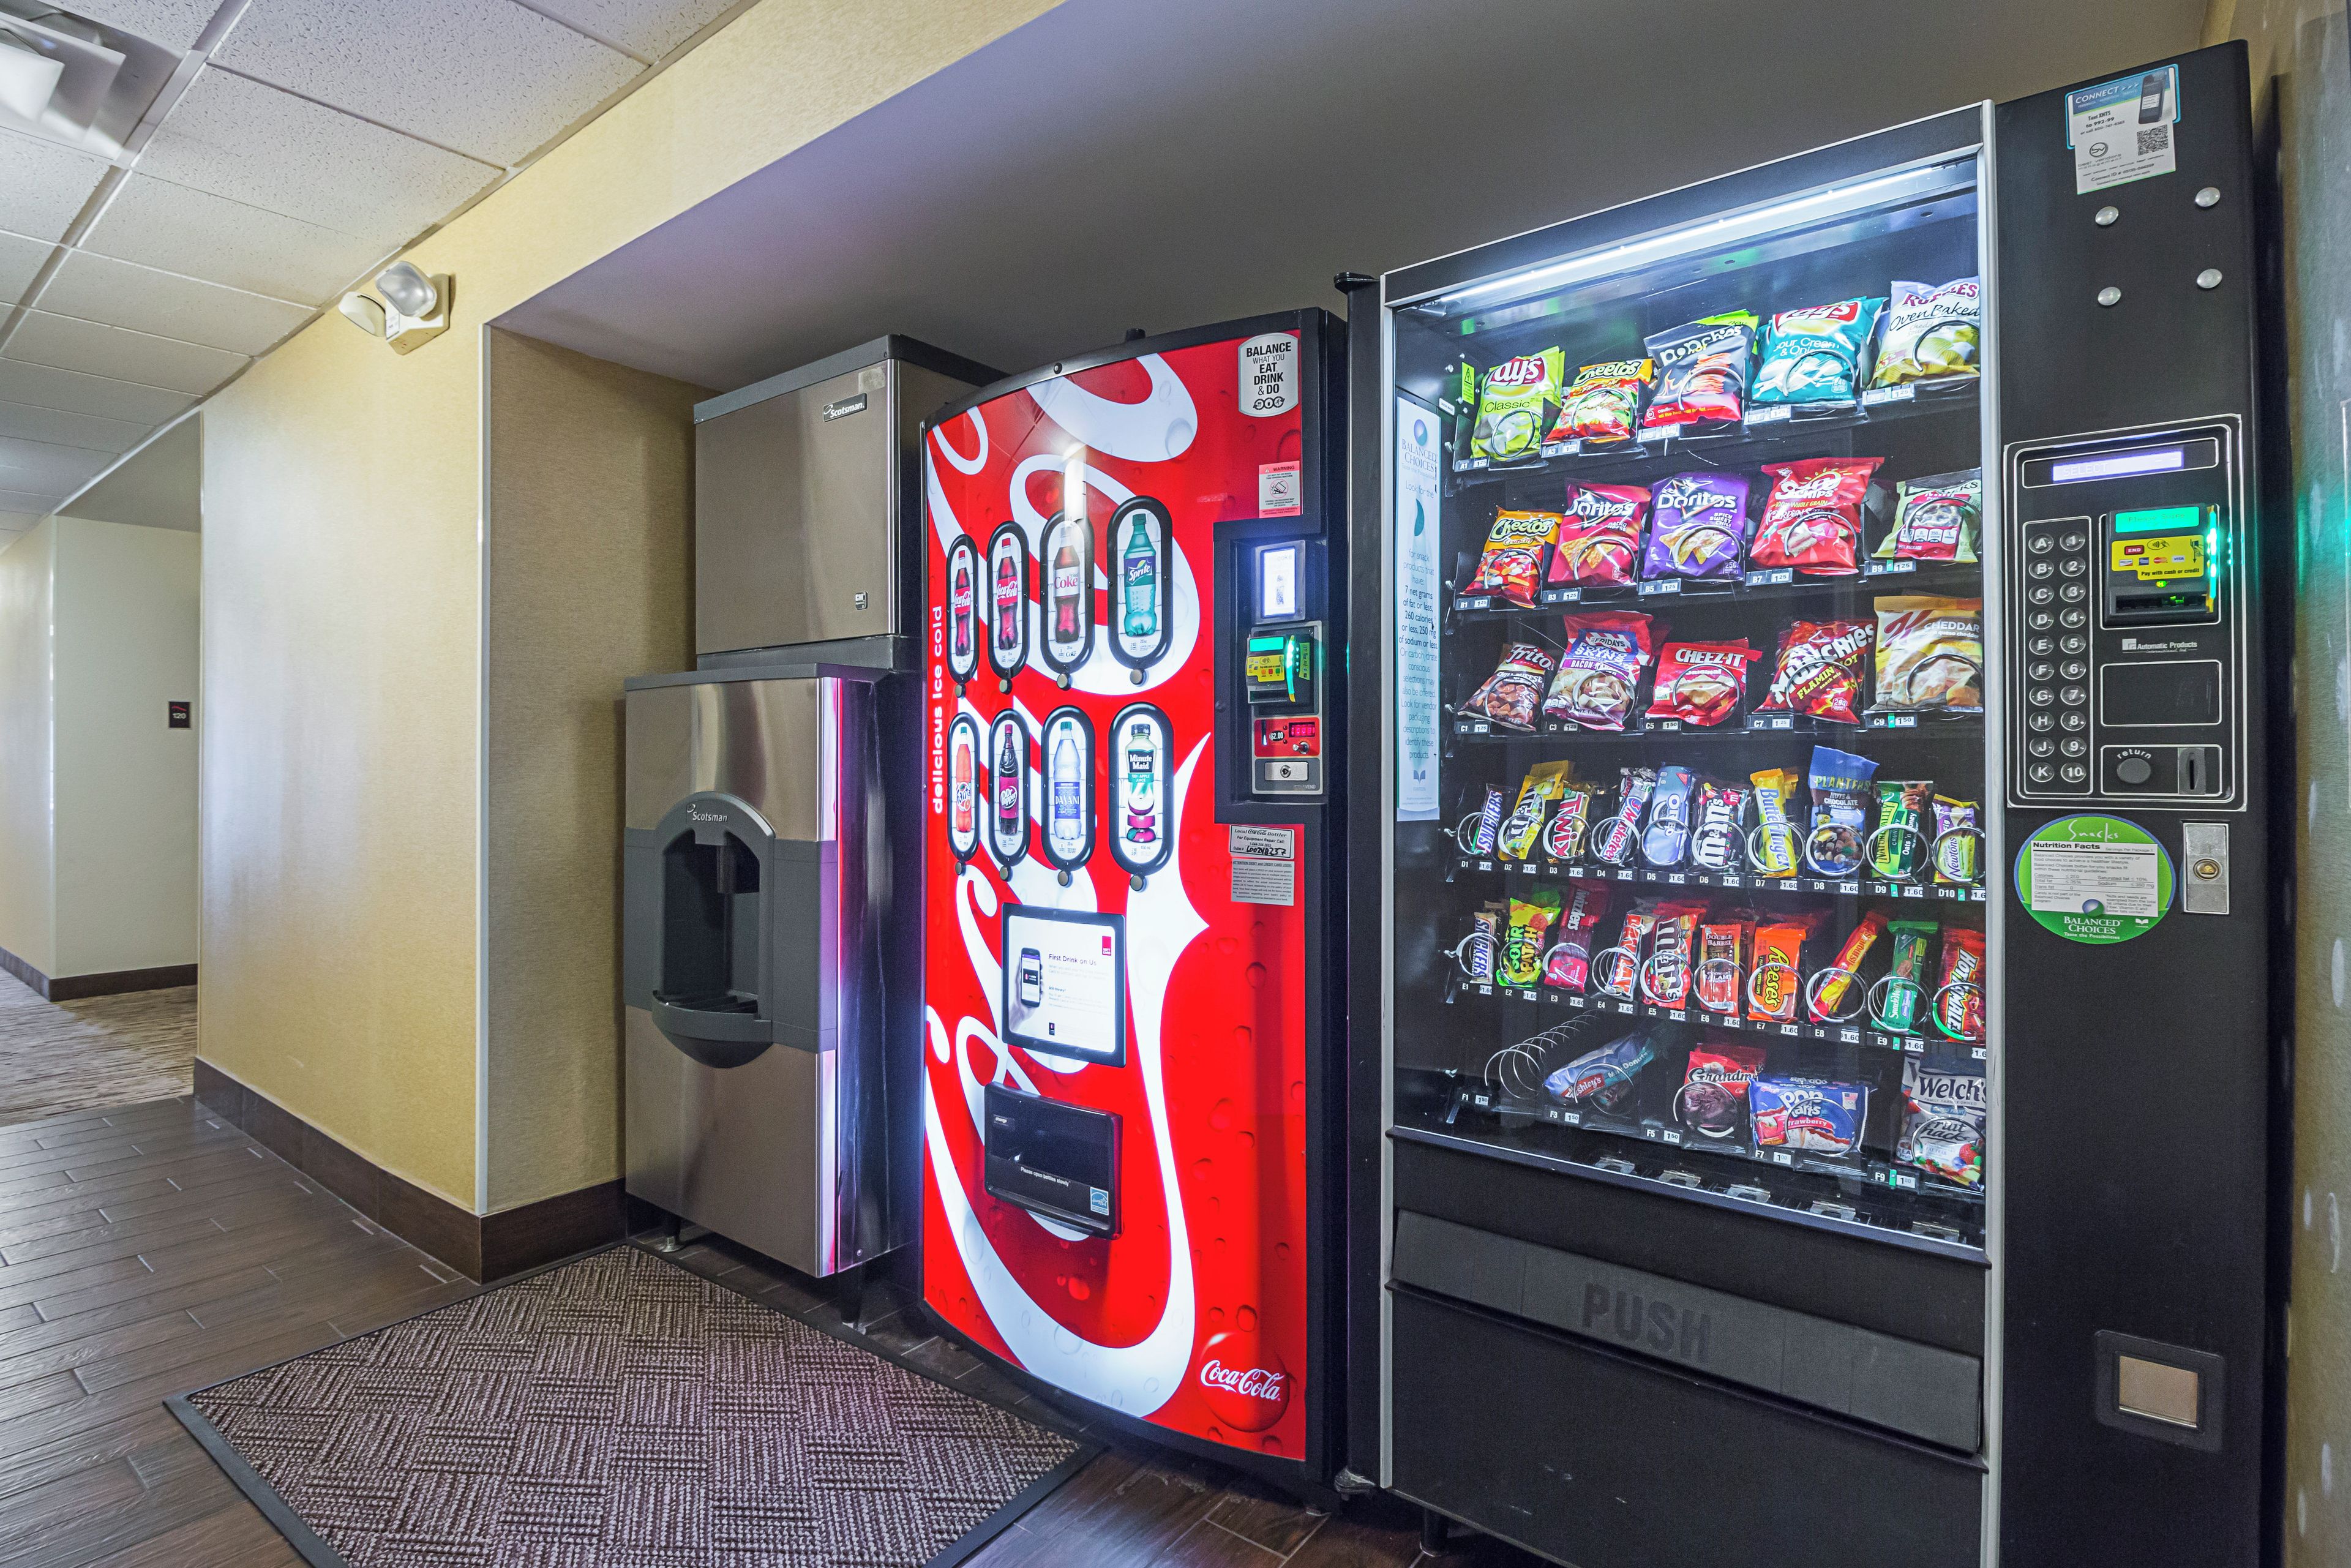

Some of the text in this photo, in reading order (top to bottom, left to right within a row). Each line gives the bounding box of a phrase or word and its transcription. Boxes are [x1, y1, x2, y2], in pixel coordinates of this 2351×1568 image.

[2075, 86, 2119, 103] CONNECT
[1889, 301, 1980, 330] Oven Baked
[1247, 342, 1291, 357] BALANCE
[1253, 353, 1284, 365] WHAT YOU
[1572, 360, 1643, 386] Cheetos
[1254, 372, 1284, 386] DRINK
[1258, 383, 1280, 396] & DO
[830, 402, 864, 418] Scotsman
[1485, 399, 1530, 413] Classic
[1402, 439, 1436, 462] BALANCED
[1405, 452, 1434, 472] CHOICES
[2063, 463, 2107, 476] SELECT
[1657, 492, 1738, 509] Doritos
[1565, 502, 1638, 516] Doritos
[1490, 519, 1554, 541] Cheetos
[1504, 536, 1534, 546] Crunchy
[2071, 536, 2076, 544] 1
[2069, 561, 2077, 571] 2
[1128, 565, 1151, 582] Sprite
[1054, 575, 1078, 589] Coke
[1419, 591, 1433, 599] grams
[2069, 587, 2077, 596] 3
[1405, 610, 1414, 620] 260
[2038, 614, 2048, 623] D
[2069, 613, 2078, 622] 4
[1924, 621, 1979, 632] CHEDDAR
[1419, 626, 1428, 635] 250
[1430, 630, 1436, 639] mg
[1405, 637, 1422, 646] sodium
[2038, 640, 2047, 649] E
[2070, 639, 2078, 648] 5
[1507, 645, 1555, 671] Fritos
[1574, 646, 1627, 662] SKINS
[1675, 648, 1745, 667] CHEEZ-IT
[1571, 659, 1594, 668] BACON
[2070, 664, 2078, 673] 6
[2039, 665, 2047, 675] F
[1797, 666, 1836, 700] FLAMIN'
[1820, 678, 1833, 689] snack
[2038, 691, 2049, 700] G
[2070, 690, 2078, 699] 7
[932, 606, 943, 814] delicious ice cold
[2038, 716, 2048, 726] H
[2070, 716, 2078, 726] 8
[1269, 732, 1283, 740] $2.00
[2039, 742, 2047, 751] J
[2070, 741, 2079, 751] 9
[2117, 748, 2151, 759] return
[2038, 767, 2049, 776] K
[2068, 768, 2082, 776] 10
[1055, 795, 1080, 805] DASANI
[692, 811, 728, 822] Scotsman
[1477, 790, 1502, 852] SNICKERS
[2068, 820, 2118, 842] Snacks
[1902, 839, 1911, 855] Oats
[1950, 838, 1961, 877] Newtons
[2064, 917, 2120, 926] BALANCED
[2068, 925, 2116, 934] CHOICES
[1509, 926, 1524, 970] SOUR
[1646, 1129, 1655, 1138] F5
[1755, 1150, 1764, 1158] F7
[1021, 1166, 1033, 1175] Please
[1043, 1174, 1056, 1182] bottles
[1057, 1177, 1069, 1187] slowly
[1875, 1172, 1885, 1181] F9
[1582, 1280, 1712, 1362] PUSH
[1201, 1359, 1284, 1400] Coca-Cola
